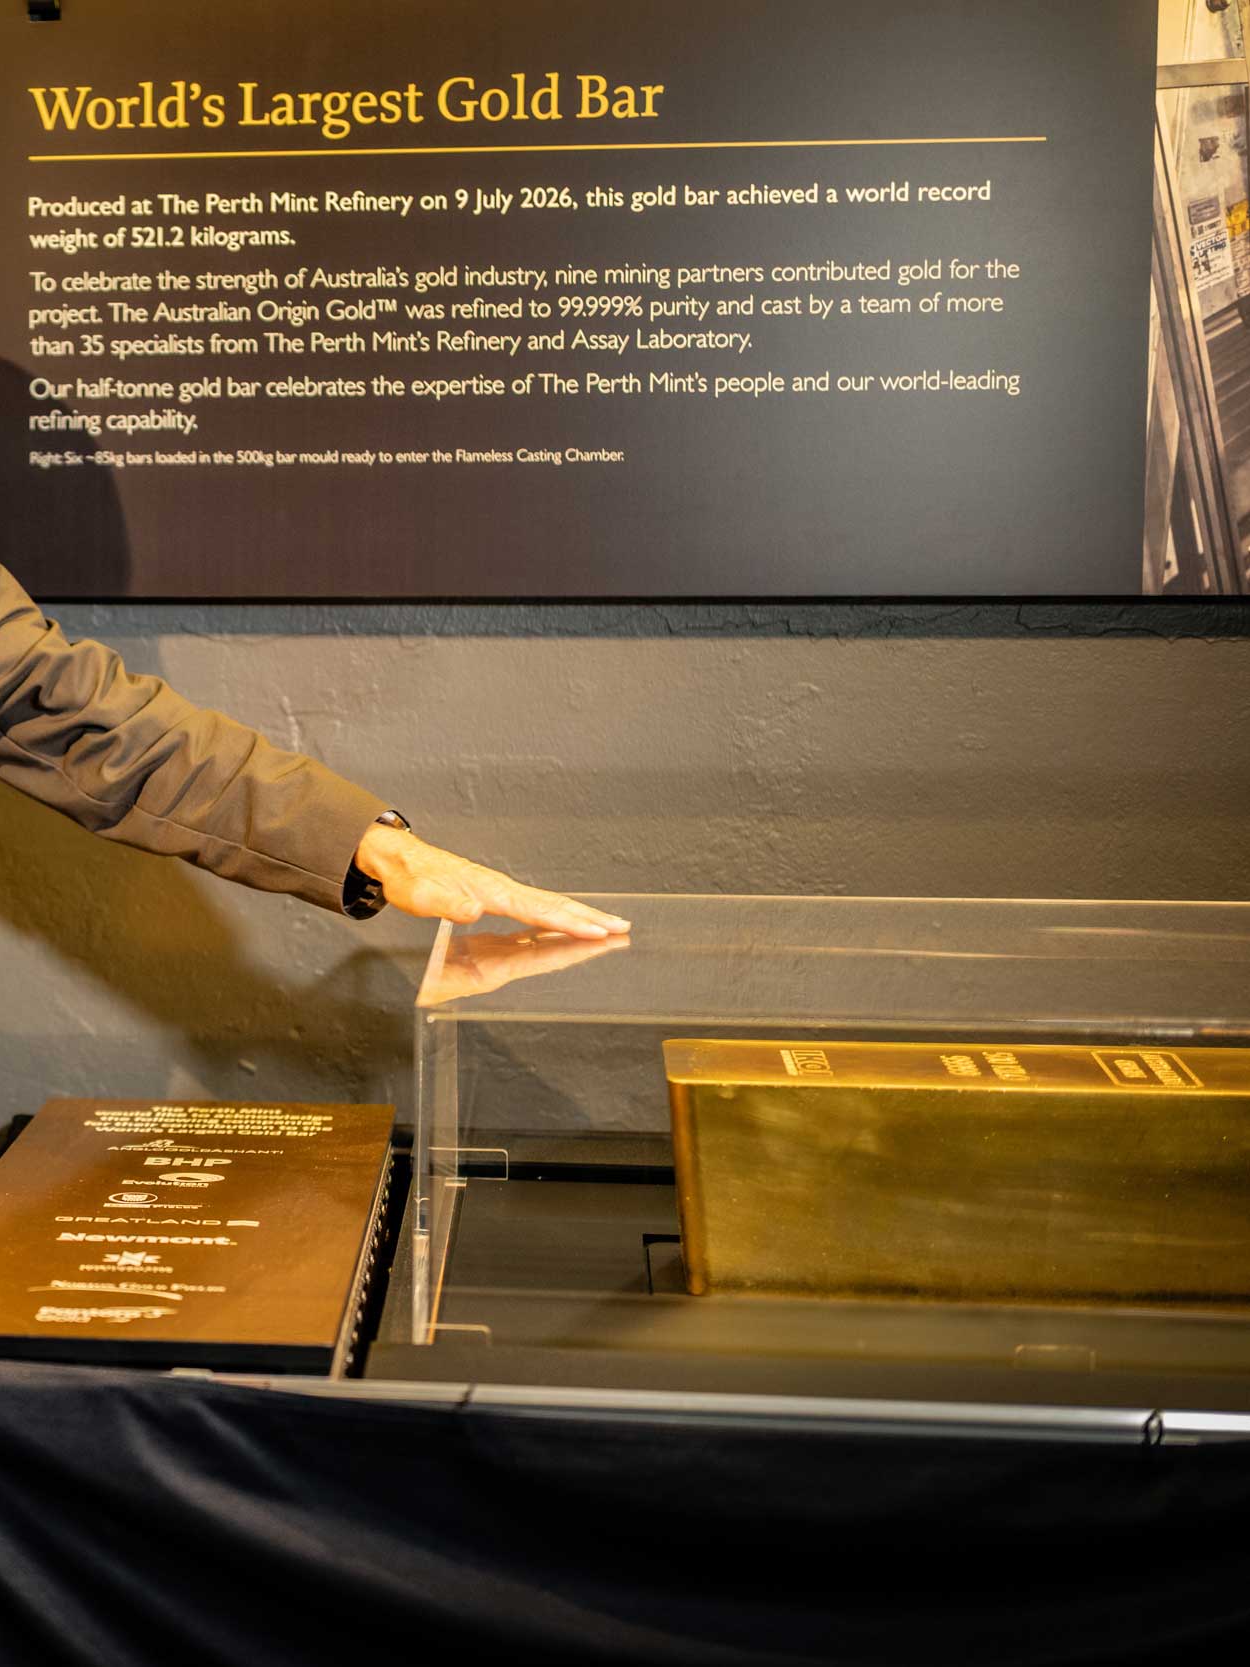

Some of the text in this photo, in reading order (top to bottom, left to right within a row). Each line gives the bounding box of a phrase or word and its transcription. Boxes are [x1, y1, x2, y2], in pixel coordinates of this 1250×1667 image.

[28, 72, 664, 139] World's Largest Gold Bar
[28, 180, 990, 217] Produced at The Perth Mint Refinery on 9 July 2026, this gold bar achieved a world record
[29, 226, 296, 255] weight of 521.2 kilograms.
[29, 259, 1019, 295] To celebrate the strength of Australia's gold industry, nine mining partners contributed gold for the
[29, 304, 103, 329] project.
[108, 303, 148, 323] The
[153, 301, 251, 322] Australian
[257, 300, 319, 327] Origin
[405, 304, 445, 319] was
[452, 297, 522, 319] refined
[528, 300, 551, 318] to
[650, 295, 710, 322] purity
[717, 294, 753, 315] and
[762, 297, 802, 314] cast
[810, 294, 833, 319] by
[841, 299, 852, 313] a
[858, 296, 910, 313] team
[919, 292, 942, 312] of
[947, 298, 1003, 312] more
[30, 328, 752, 360] than 35 specialists from The Perth Mint's Refinery and Assay Laboratory.
[30, 370, 1020, 403] Our half-tonne gold bar celebrates the expertise of The Perth Mint's people and our world-leading
[29, 409, 198, 436] refining capability.
[126, 451, 153, 464] bars
[155, 451, 197, 464] loaded
[199, 451, 211, 463] in
[213, 451, 234, 464] the
[236, 450, 274, 467] 500kg
[276, 450, 298, 464] bar
[299, 450, 339, 464] mould
[341, 450, 376, 466] ready
[378, 451, 393, 463] to
[395, 451, 430, 463] enter
[432, 449, 452, 463] the
[456, 449, 513, 462] Flameless
[517, 448, 562, 465] Casting
[144, 1156, 232, 1167] BHP
[55, 1215, 222, 1226] GREATLAND
